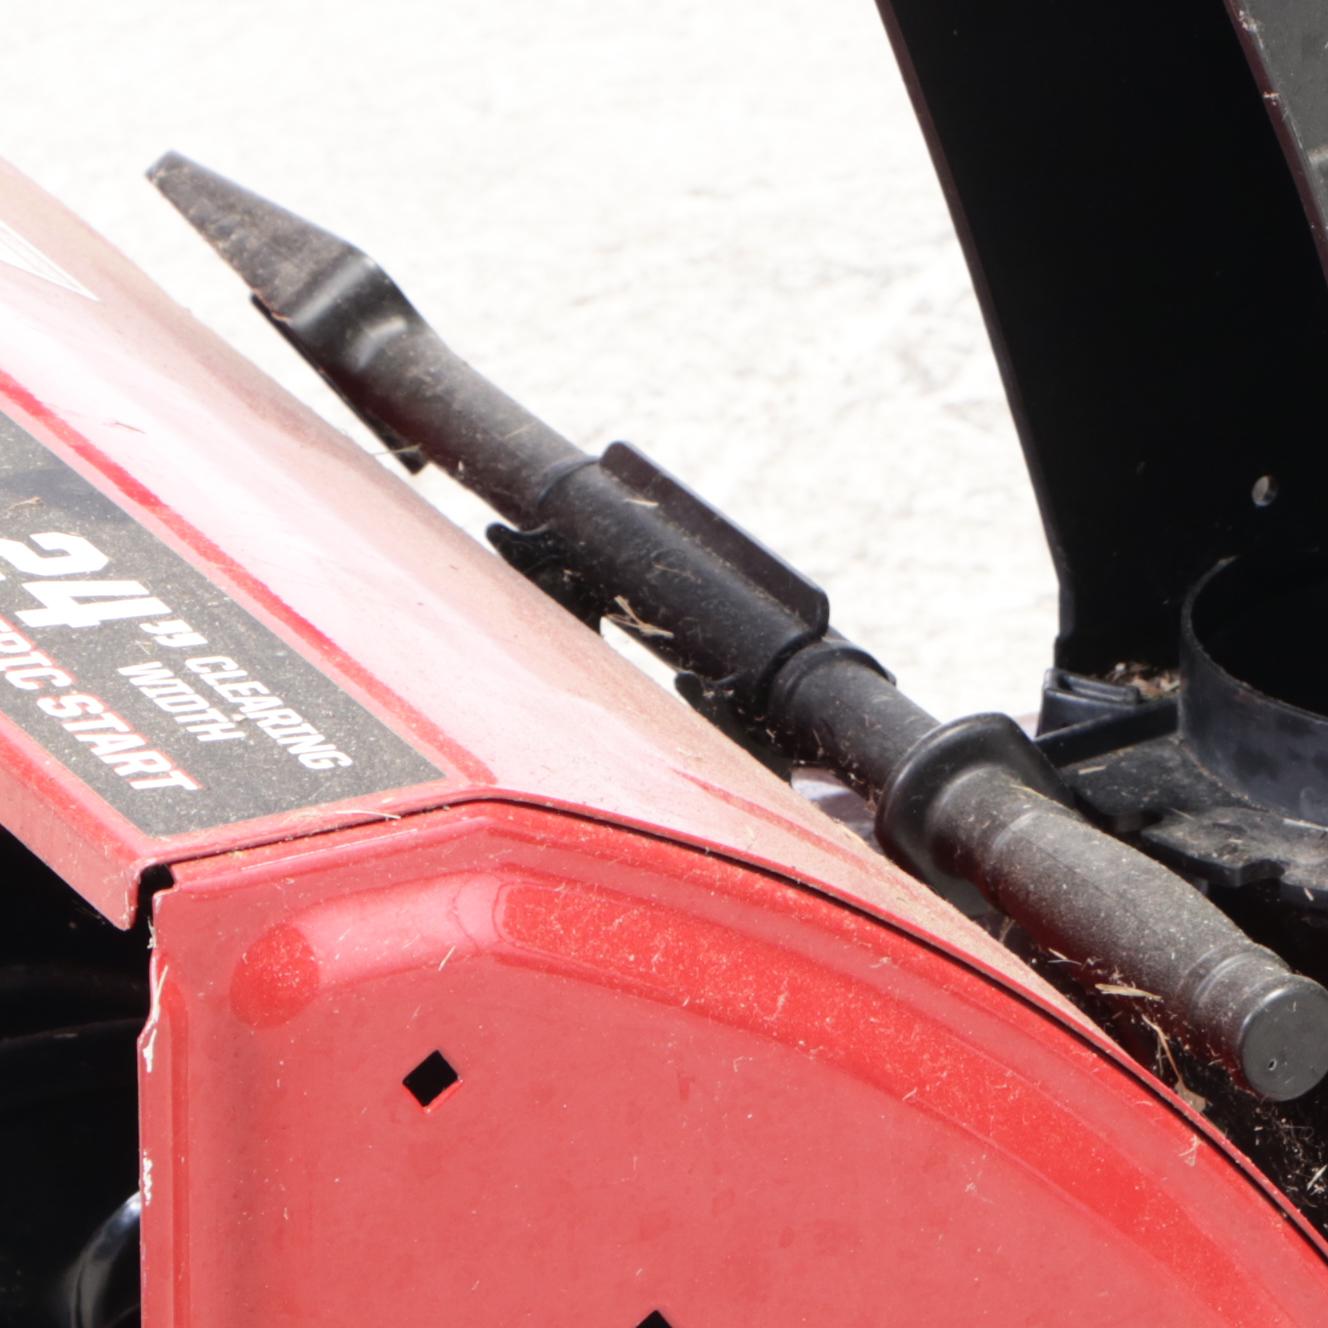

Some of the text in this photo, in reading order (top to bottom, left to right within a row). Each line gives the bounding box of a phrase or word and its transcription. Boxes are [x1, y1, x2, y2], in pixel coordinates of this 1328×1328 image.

[36, 692, 202, 791] START
[117, 660, 246, 742] WIDTH
[184, 655, 353, 770] CLEARING
